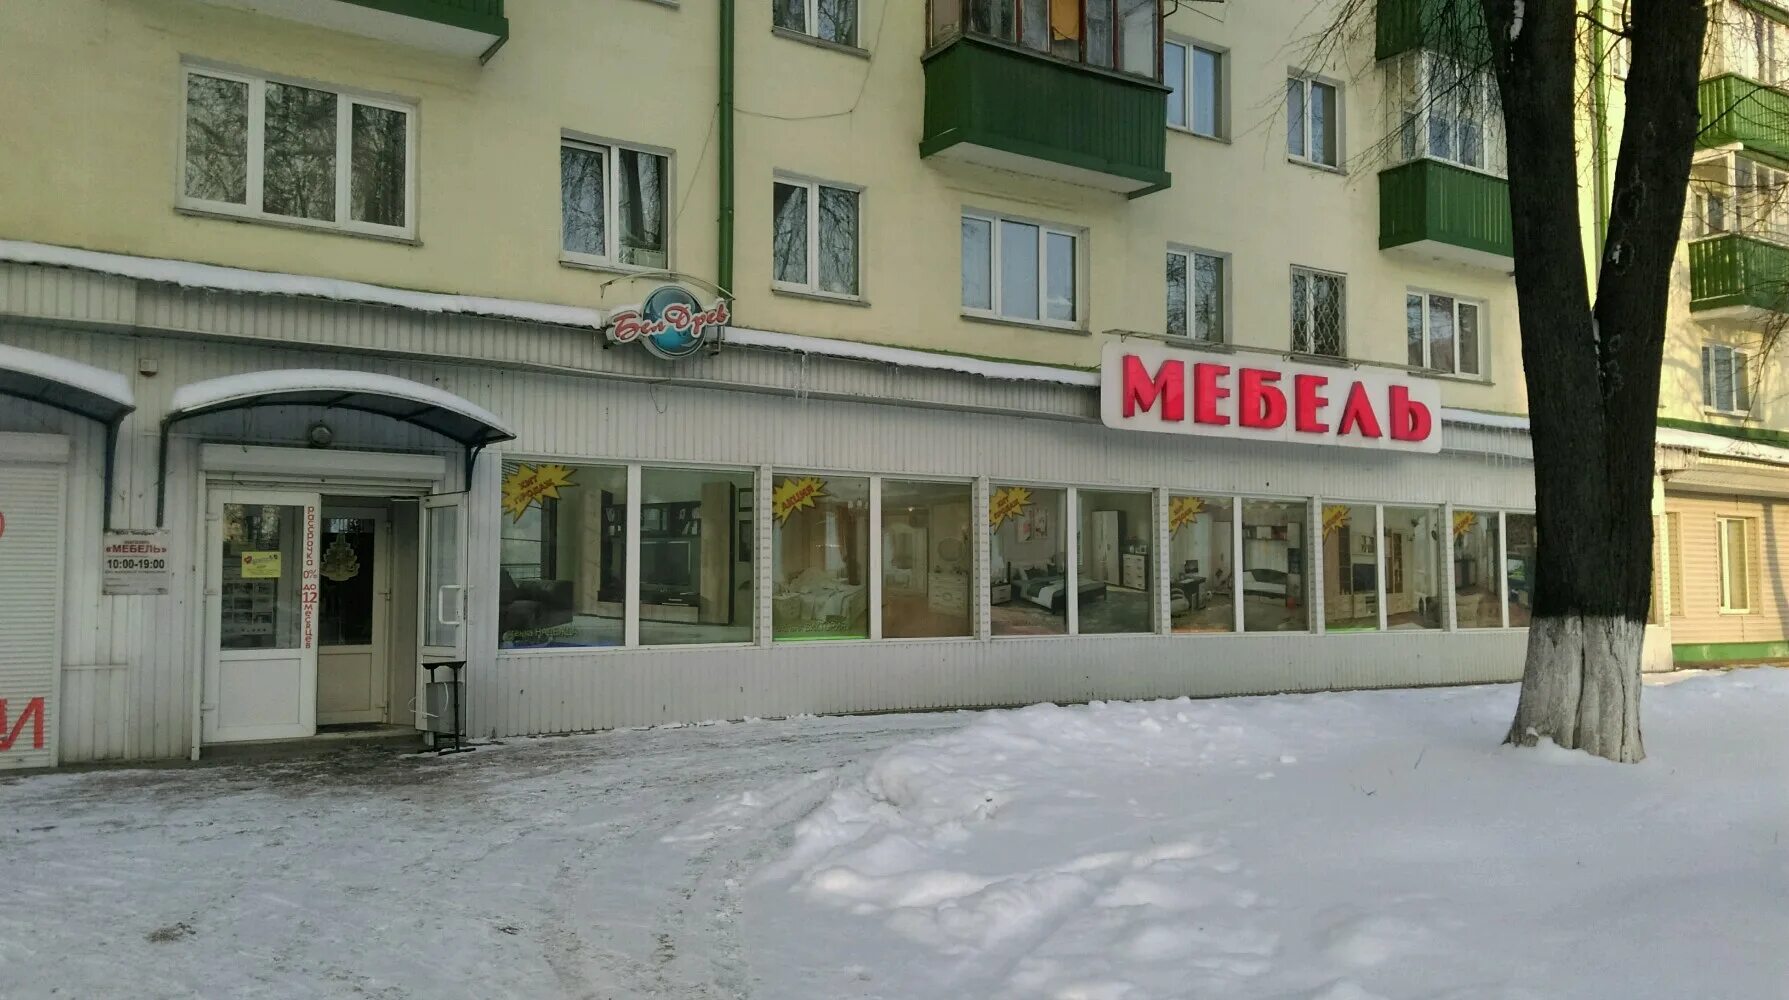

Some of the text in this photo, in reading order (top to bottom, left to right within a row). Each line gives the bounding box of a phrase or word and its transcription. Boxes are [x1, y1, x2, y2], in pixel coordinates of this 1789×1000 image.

[1123, 354, 1432, 441] МЕБЕЛЬ
[306, 506, 315, 566] рассрочка
[107, 559, 165, 569] 10:00-19:00
[303, 569, 318, 579] 0%
[303, 592, 318, 604] 12
